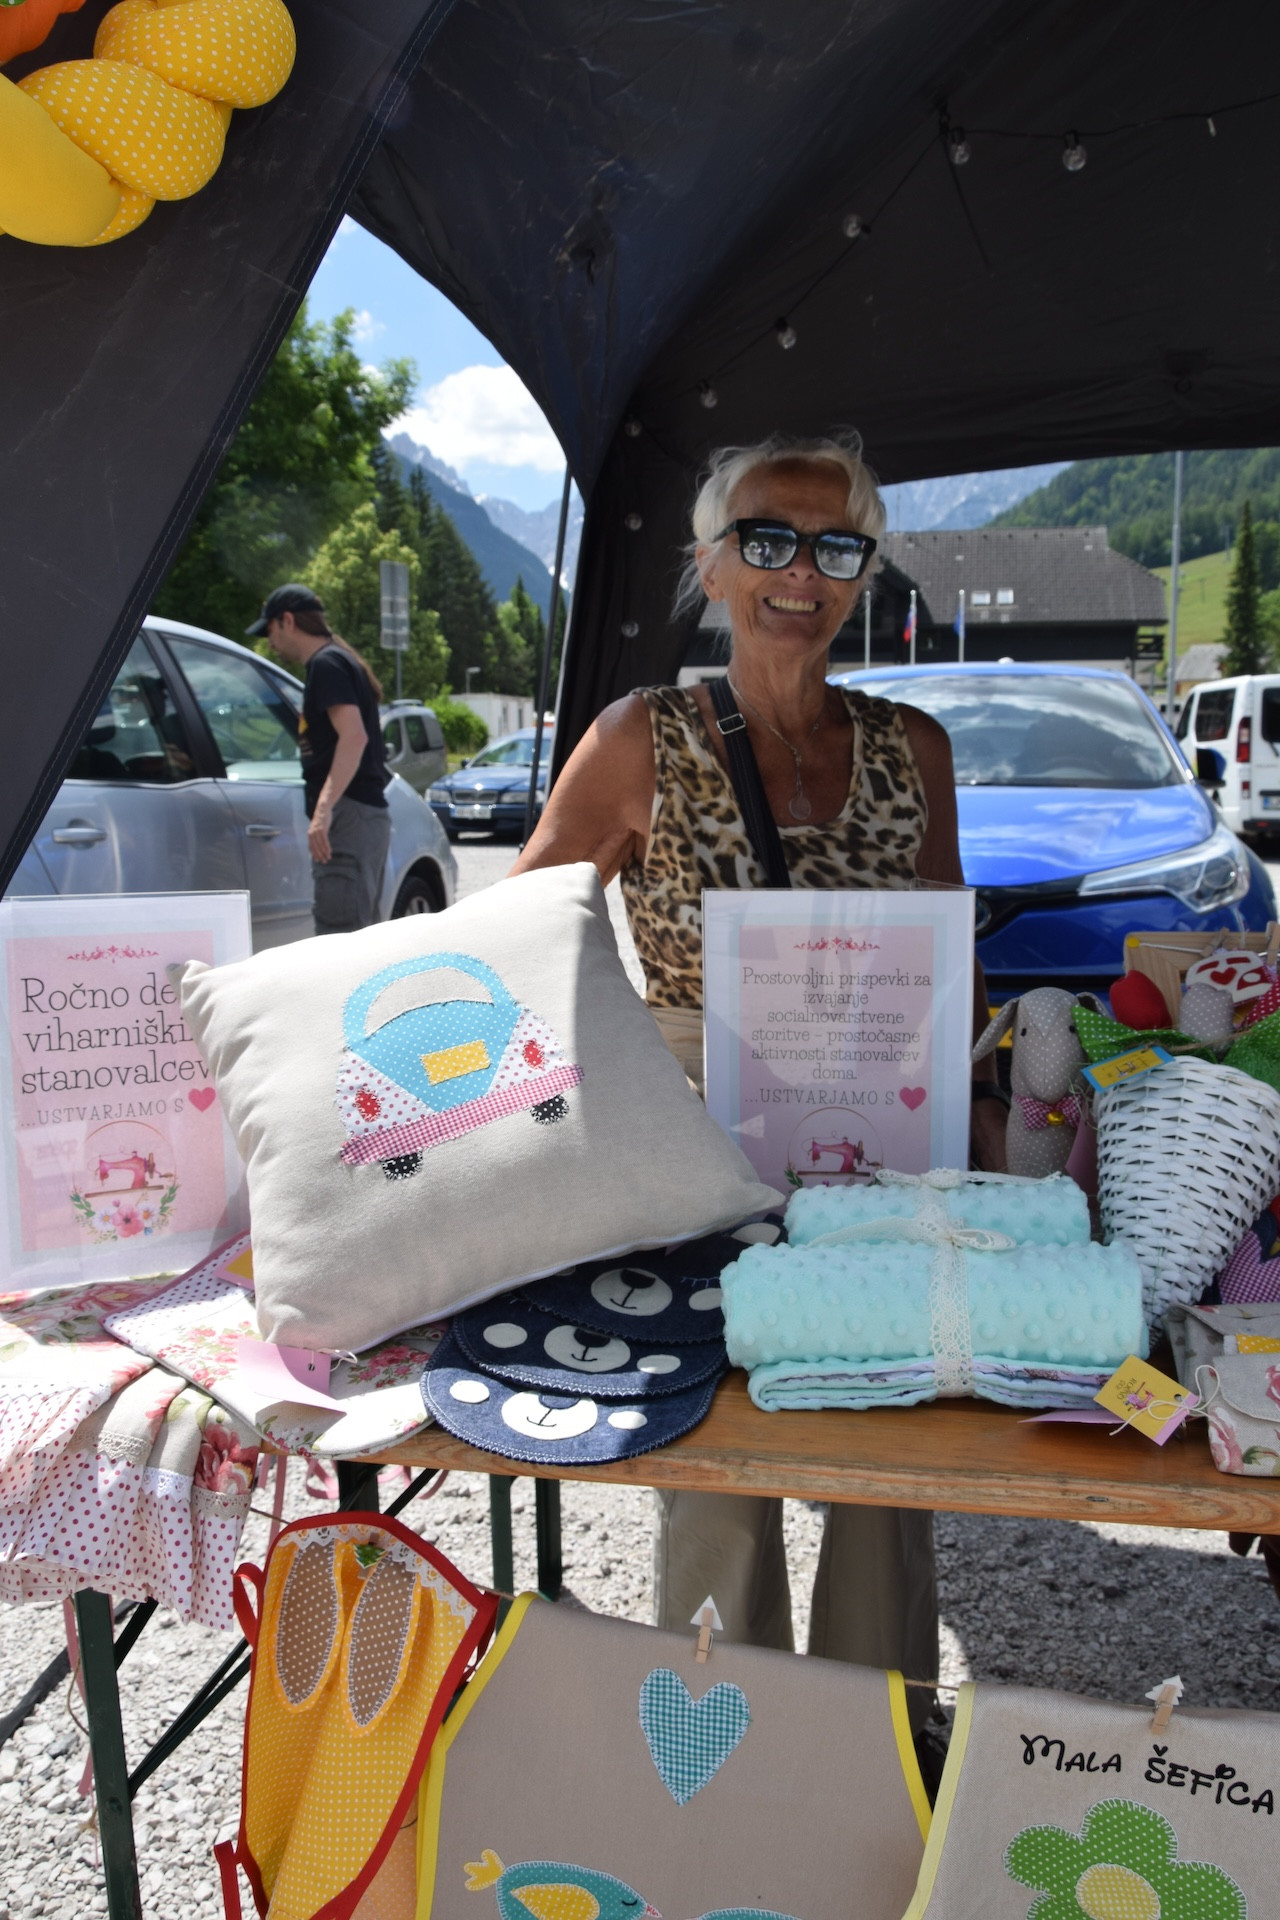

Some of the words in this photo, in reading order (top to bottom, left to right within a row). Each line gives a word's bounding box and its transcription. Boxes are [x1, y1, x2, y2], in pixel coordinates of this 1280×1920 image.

[742, 967, 834, 989] Prostovoljni
[838, 968, 910, 989] prispevki
[913, 975, 932, 986] za
[21, 977, 129, 1013] Ročno
[140, 972, 178, 1006] de
[803, 991, 869, 1008] izvajanje
[767, 1006, 905, 1024] socialnovarstvene
[23, 1010, 194, 1053] viharniški
[751, 1028, 810, 1041] storitve
[827, 1029, 921, 1045] prostočasne
[751, 1043, 826, 1061] aktivnosti
[830, 1045, 920, 1062] stanovalcev
[21, 1050, 209, 1094] stanovalcev
[812, 1063, 858, 1080] doma.
[174, 1098, 185, 1113] S
[885, 1091, 895, 1106] S
[1020, 1734, 1122, 1773] MALA
[1144, 1744, 1274, 1815] ŠEFICA
